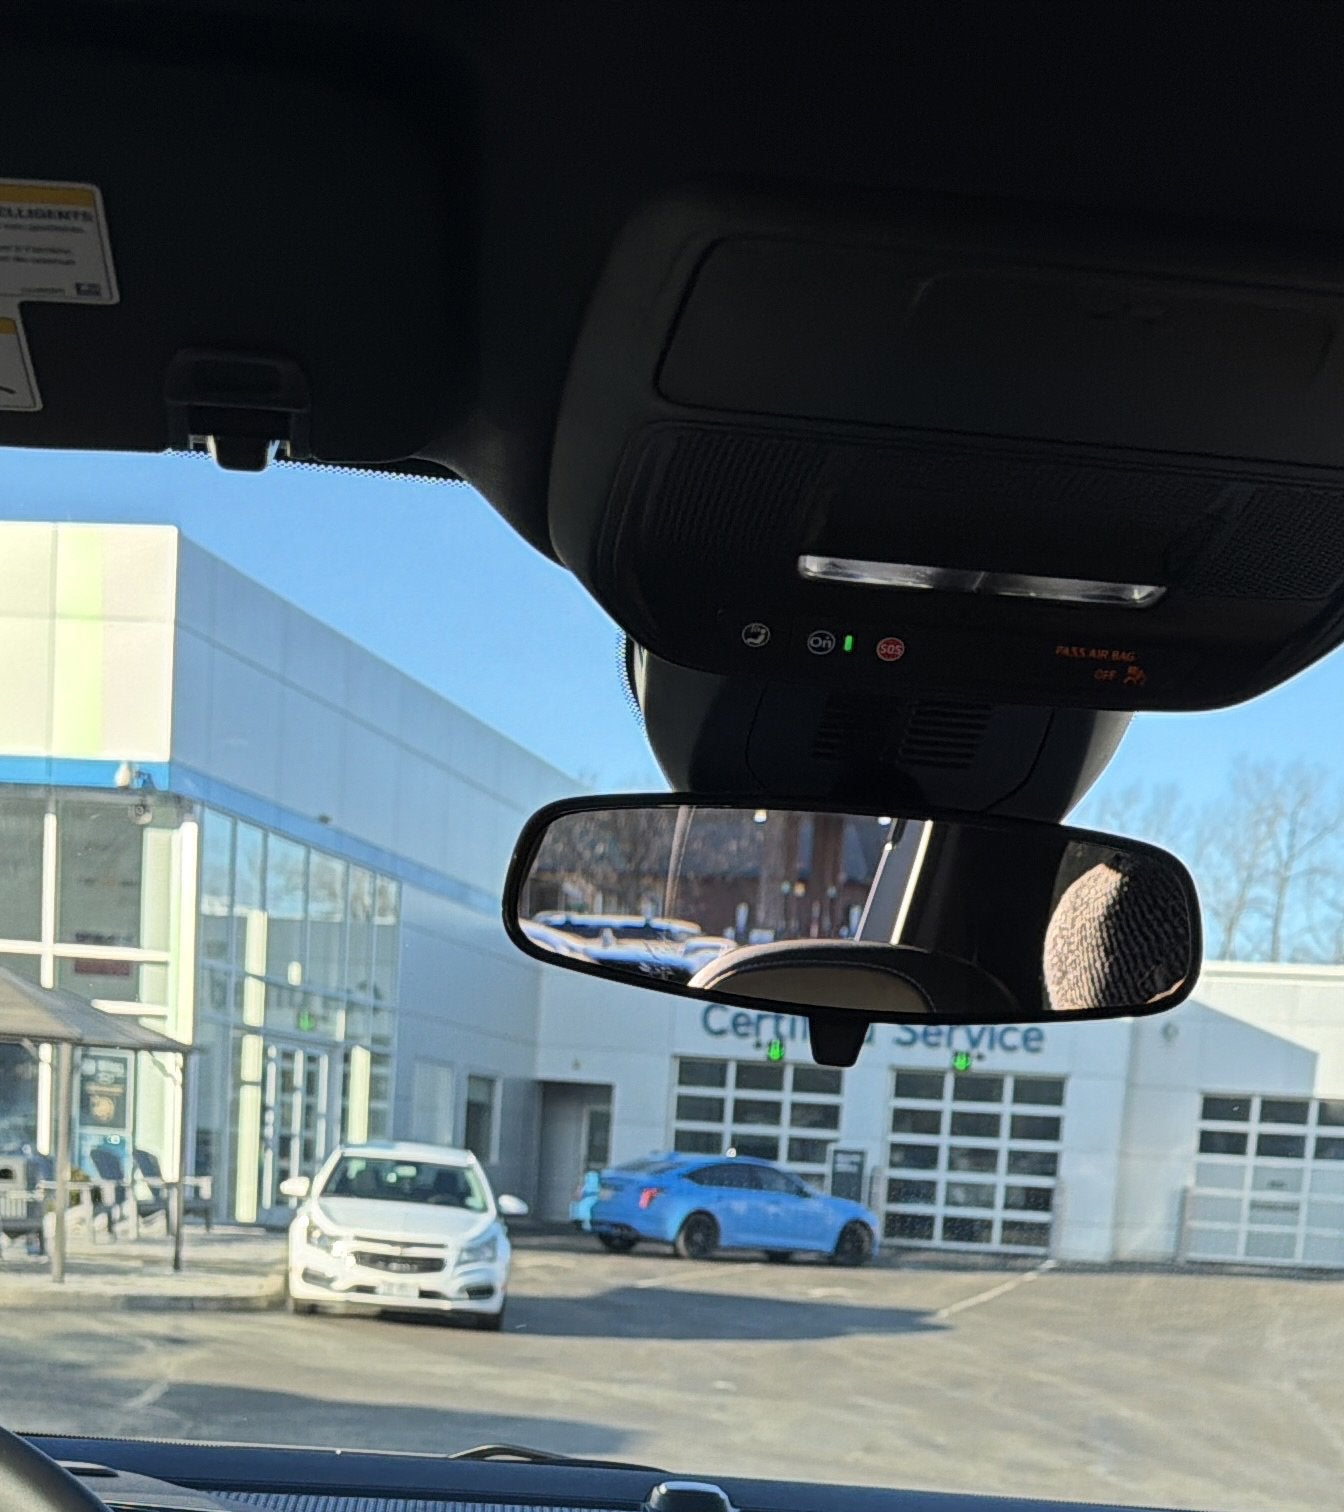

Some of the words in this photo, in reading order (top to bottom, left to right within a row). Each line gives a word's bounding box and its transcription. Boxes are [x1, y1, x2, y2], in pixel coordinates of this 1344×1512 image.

[879, 643, 903, 654] SOS
[1088, 648, 1110, 659] AIR
[1111, 650, 1137, 662] BAG
[1094, 668, 1119, 681] OFF
